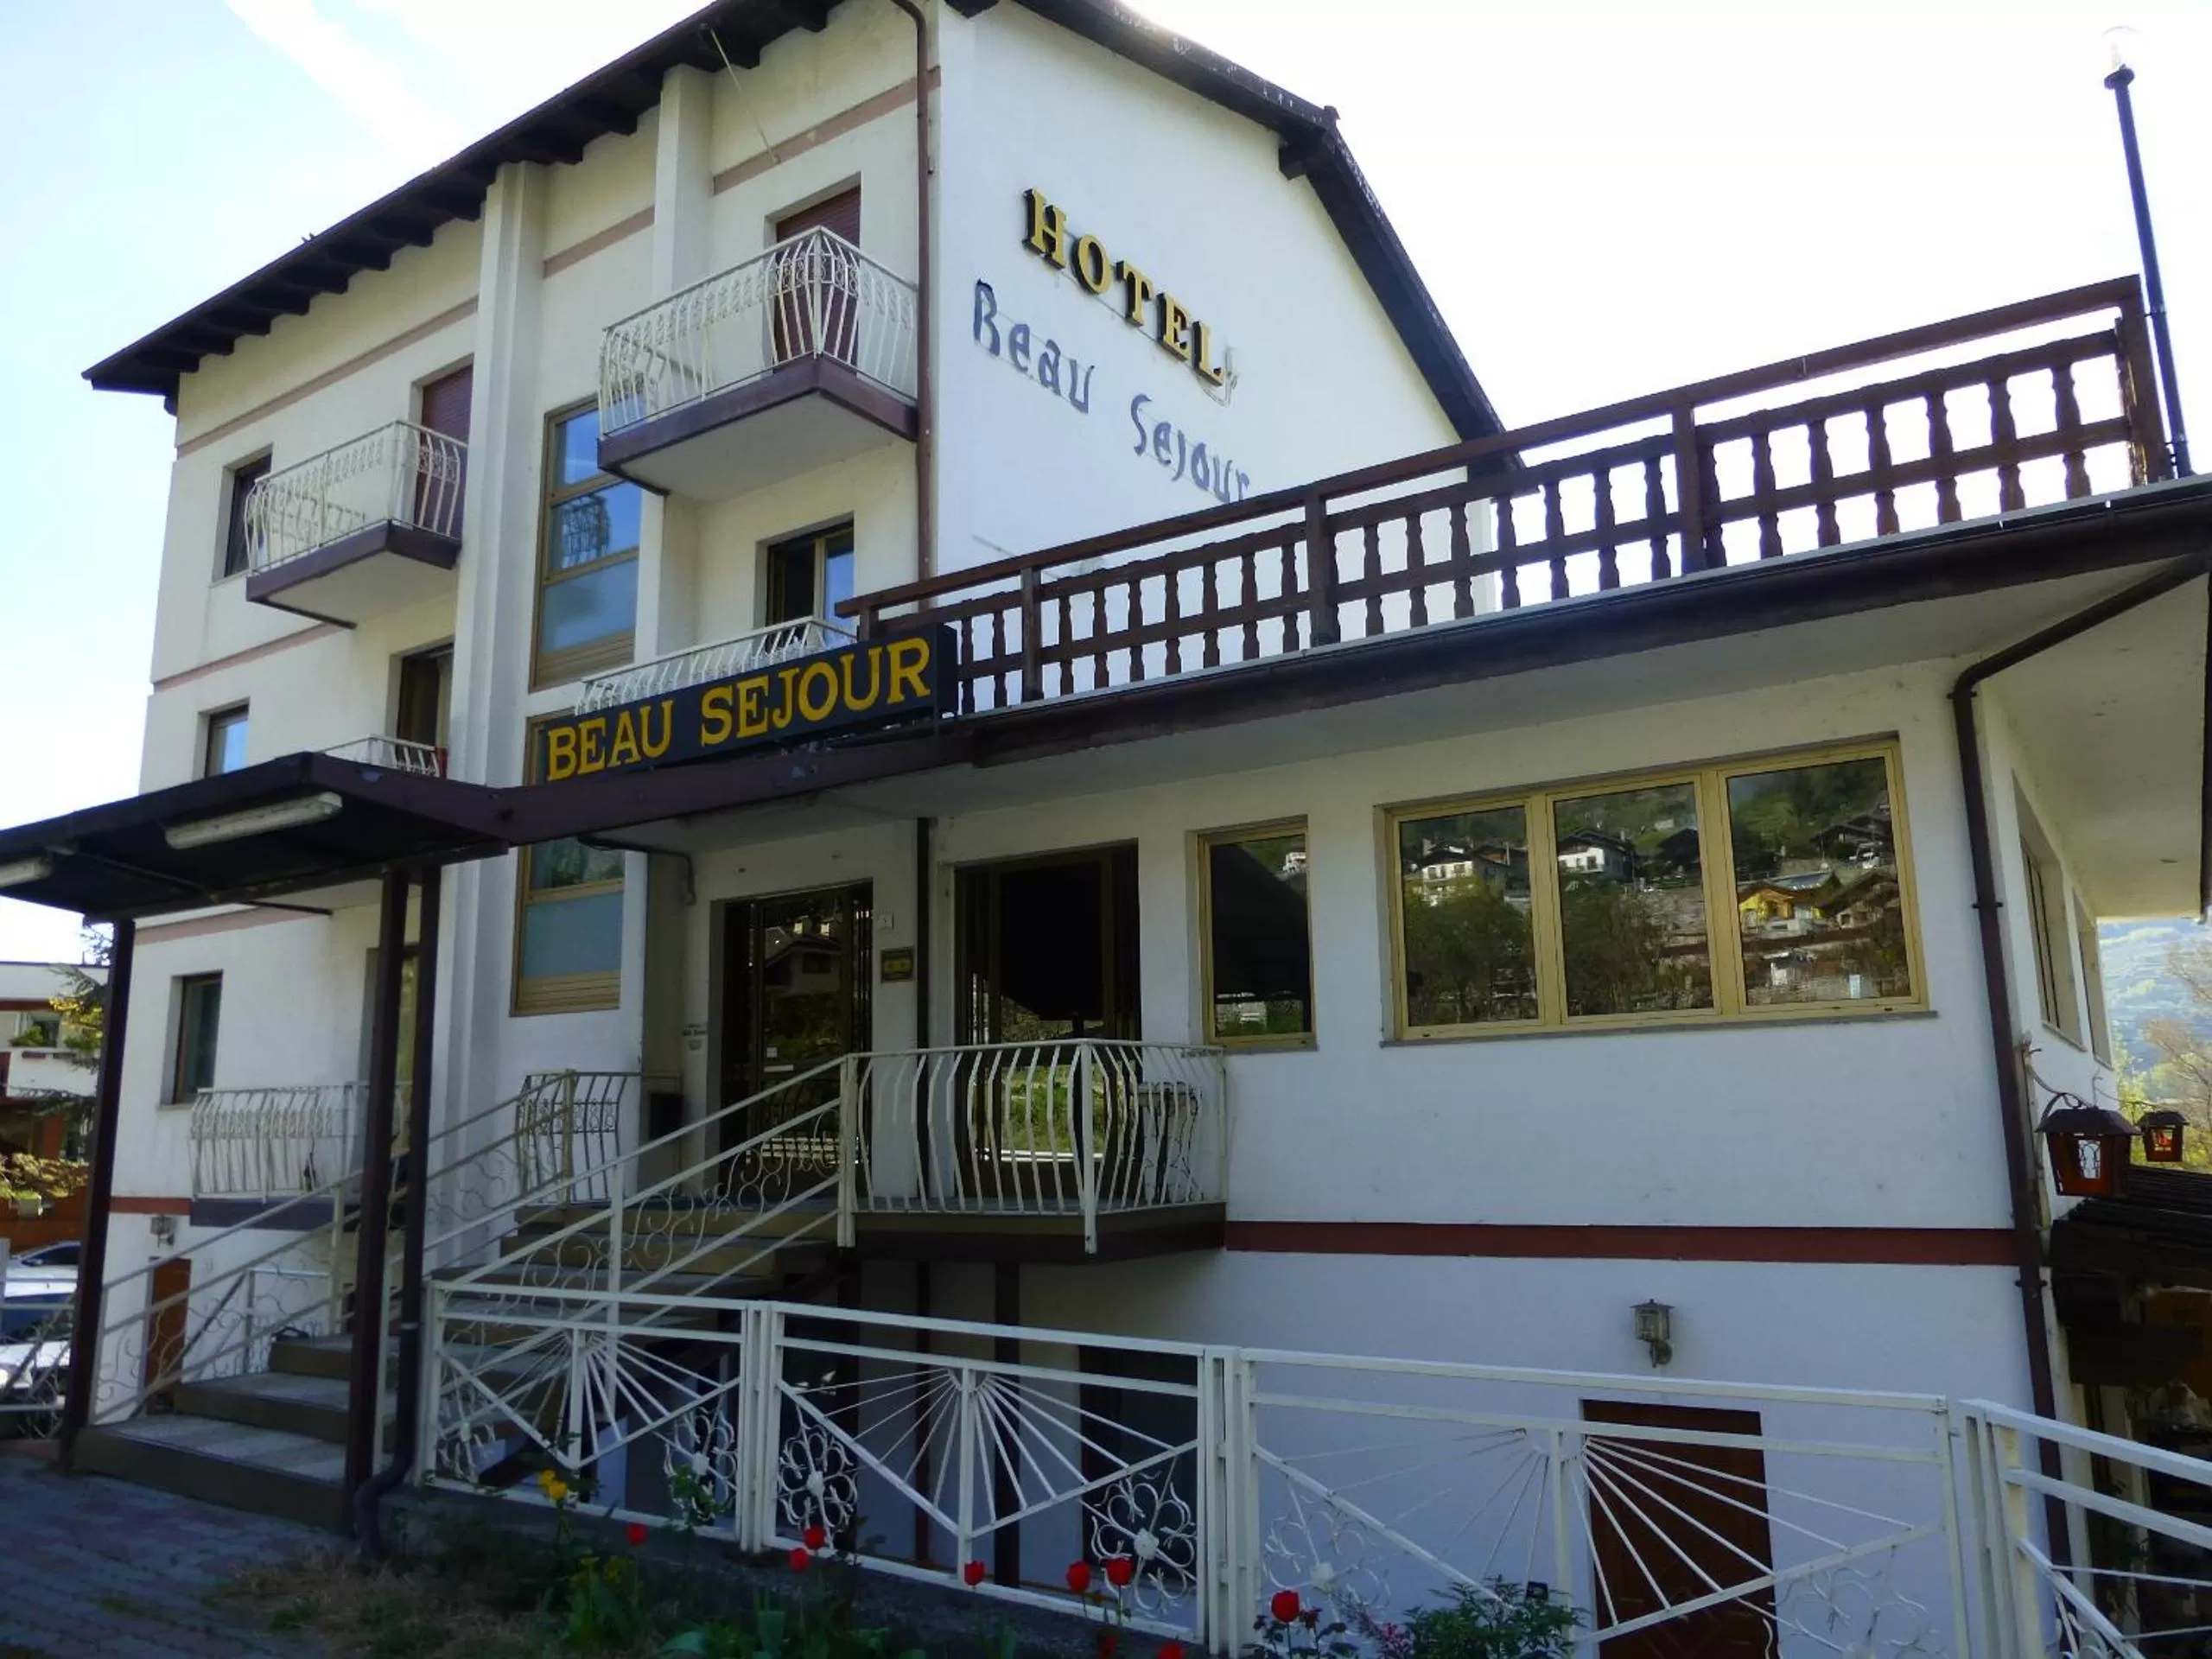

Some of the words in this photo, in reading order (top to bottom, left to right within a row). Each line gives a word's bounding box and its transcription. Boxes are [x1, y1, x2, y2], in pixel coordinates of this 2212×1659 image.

[1022, 187, 1224, 387] HOTEL
[547, 699, 673, 782] BEAU
[701, 638, 931, 747] SEJOUR
